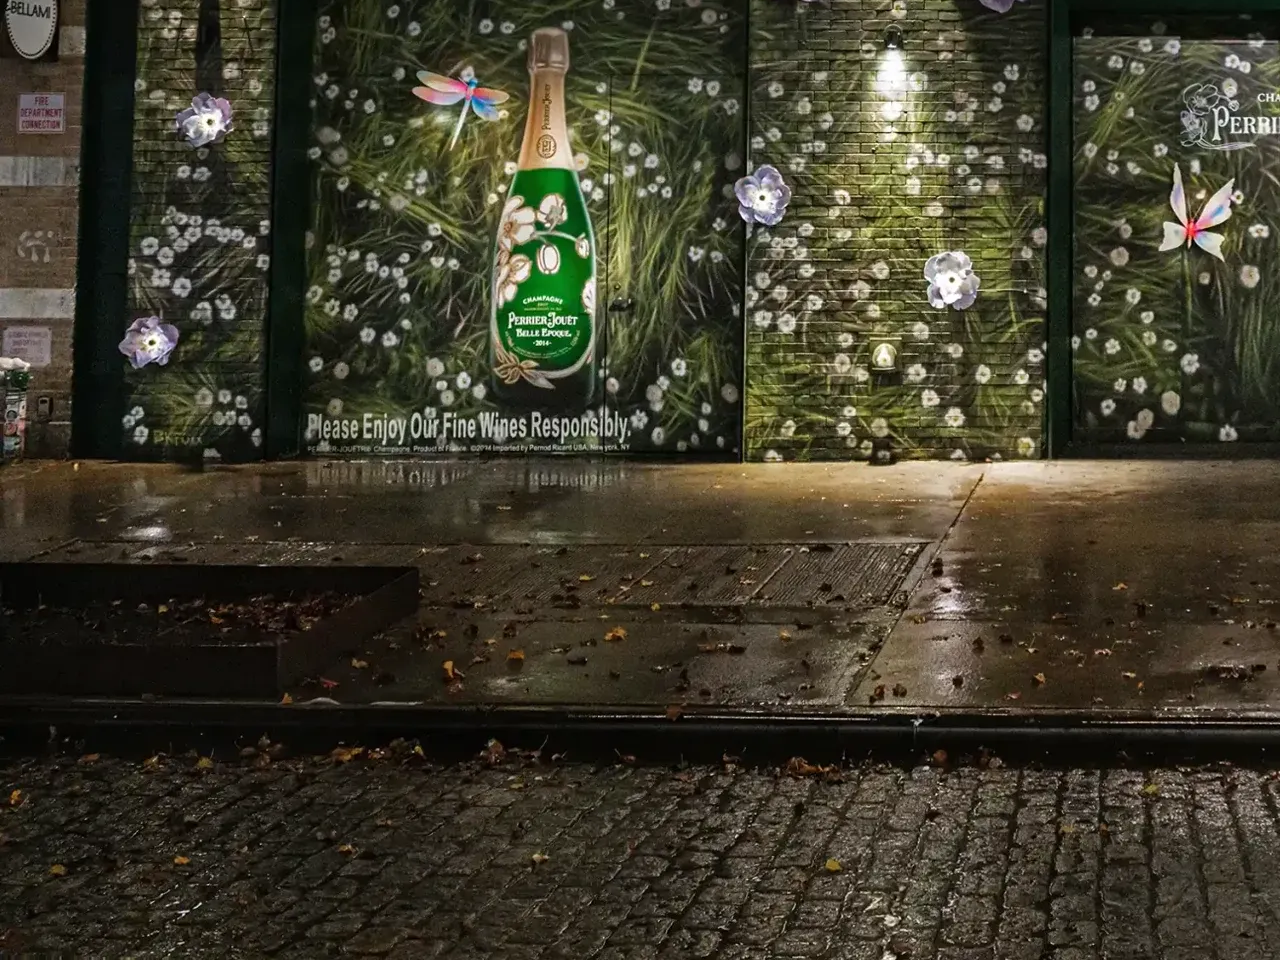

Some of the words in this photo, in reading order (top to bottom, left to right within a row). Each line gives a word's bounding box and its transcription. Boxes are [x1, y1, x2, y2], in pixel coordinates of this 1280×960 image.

[11, 0, 50, 19] BELLAMI
[35, 96, 49, 105] FIRE
[21, 108, 62, 117] DEPARTMENT
[21, 120, 60, 129] CONNECTION
[523, 295, 563, 304] CHAMPAGNE
[516, 329, 540, 337] BELLE
[308, 413, 358, 439] Please
[363, 413, 406, 445] Enjoy
[411, 412, 439, 439] Our
[443, 412, 476, 439] Fine
[479, 411, 527, 438] Wines
[531, 411, 631, 444] Responsibly.
[413, 444, 437, 452] Product
[493, 444, 520, 452] Imported
[521, 444, 528, 453] by
